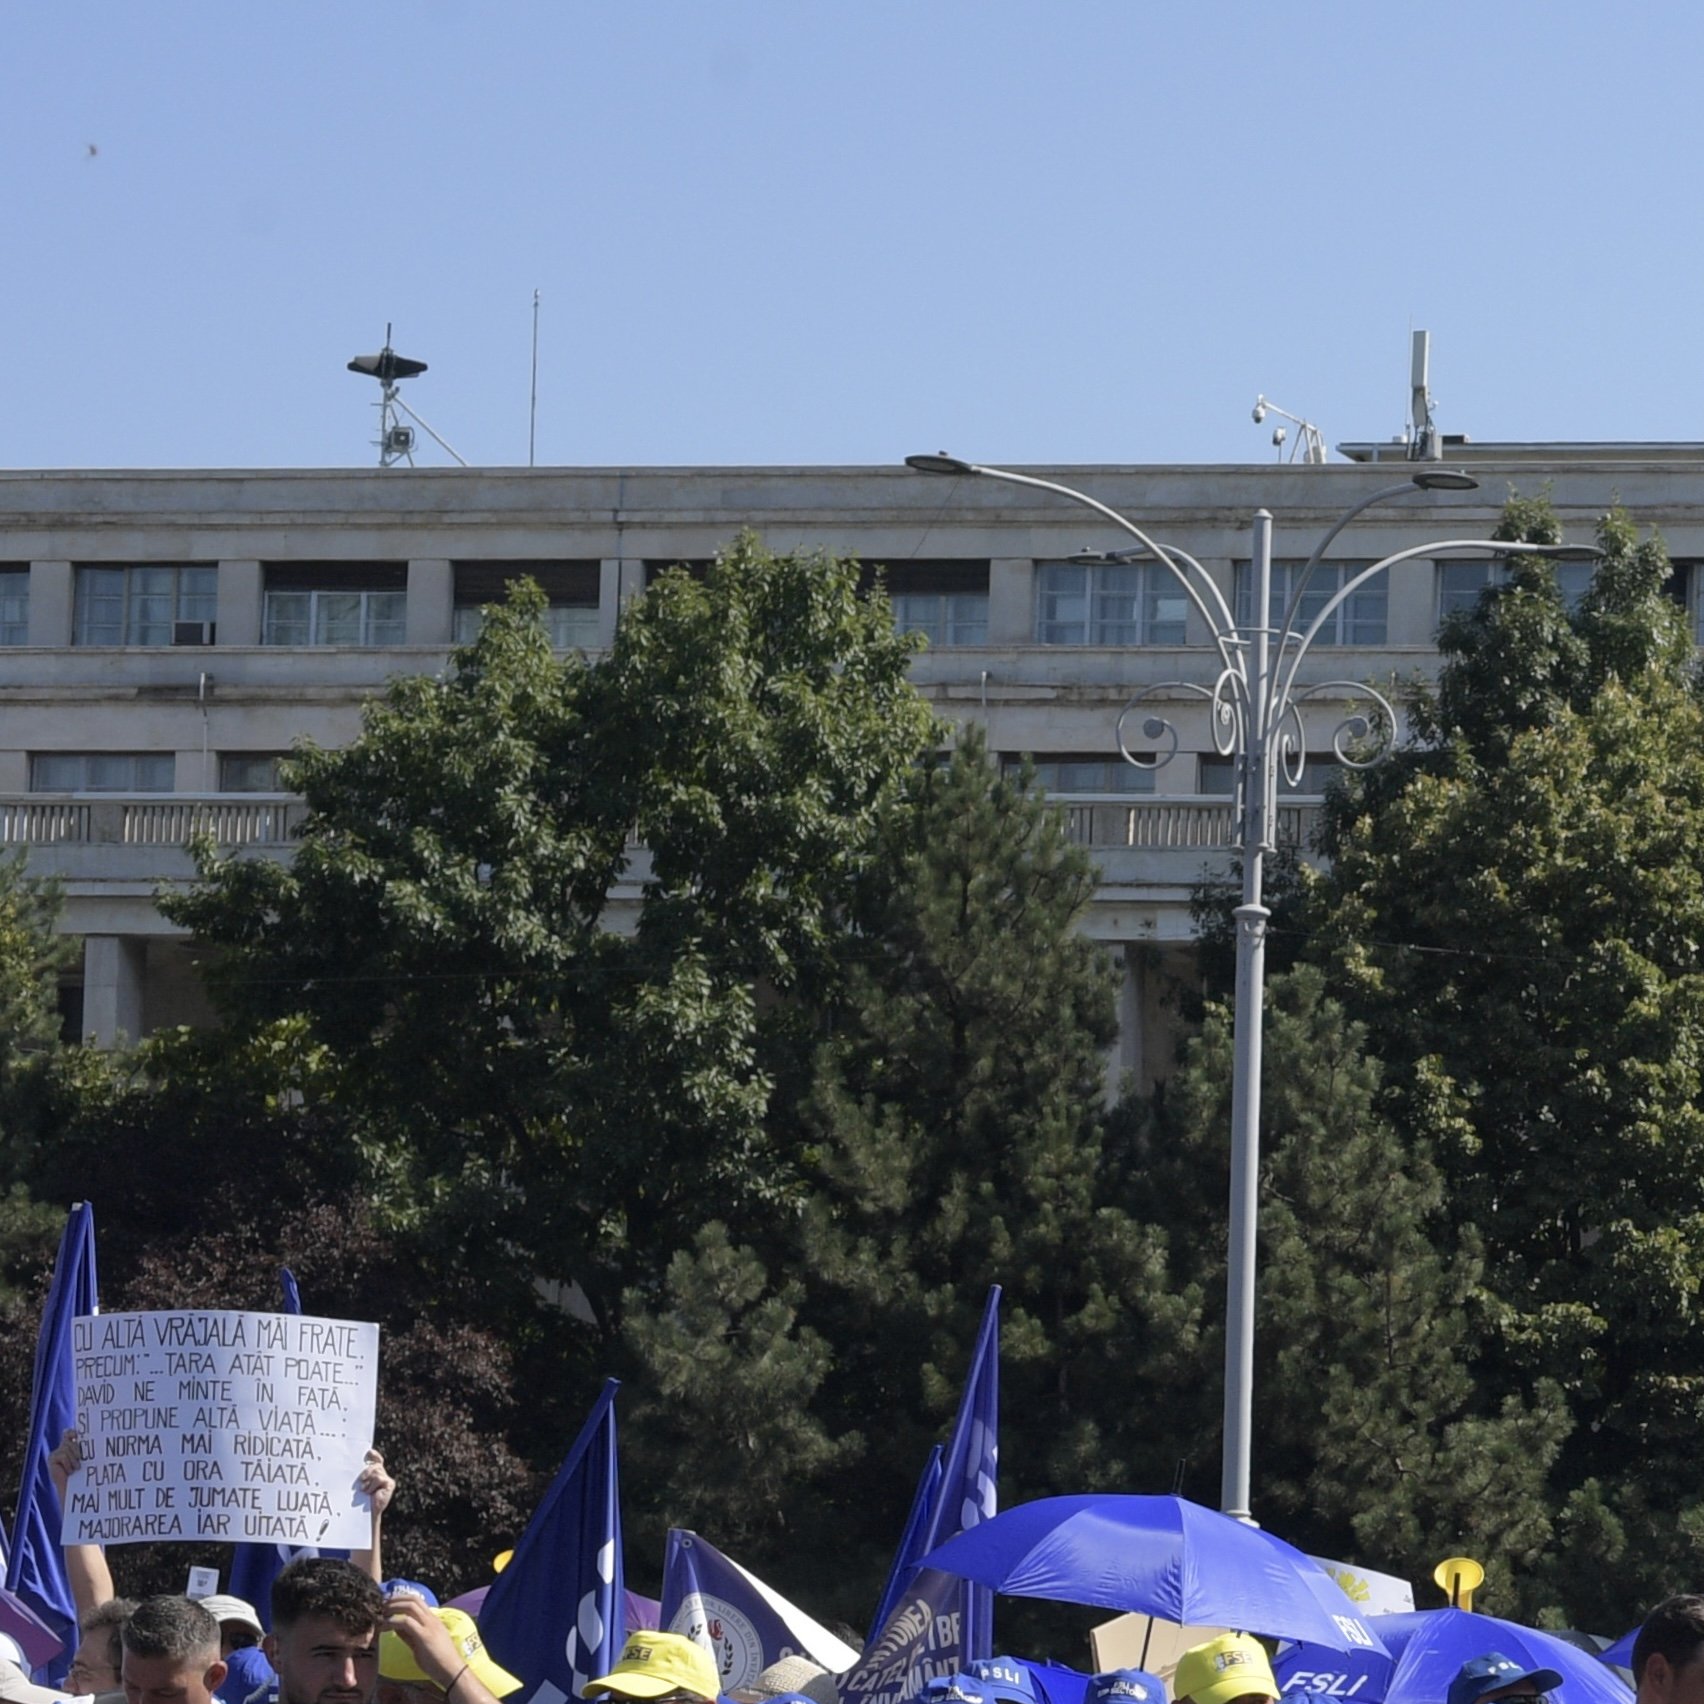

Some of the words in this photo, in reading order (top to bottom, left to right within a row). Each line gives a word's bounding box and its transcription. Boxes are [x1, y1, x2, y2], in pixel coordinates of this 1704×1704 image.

[74, 1322, 93, 1352] CU
[77, 1380, 116, 1408] DAVID
[133, 1381, 156, 1402] NE
[178, 1376, 233, 1402] MINTE
[256, 1378, 274, 1403] ÎN
[100, 1407, 180, 1432] PROPUNE
[79, 1439, 96, 1460] CU
[105, 1434, 162, 1457] NORMA
[181, 1430, 212, 1454] MAI
[86, 1463, 126, 1487] PLATA
[142, 1461, 165, 1482] CU
[183, 1460, 223, 1481] ORA
[71, 1488, 100, 1514] MAI
[108, 1488, 145, 1511] MULT
[155, 1487, 175, 1508] DE
[188, 1486, 262, 1510] JUMATE
[78, 1513, 182, 1540] MAJORAREA
[197, 1508, 230, 1536] IAR
[1281, 1671, 1369, 1697] FSLI
